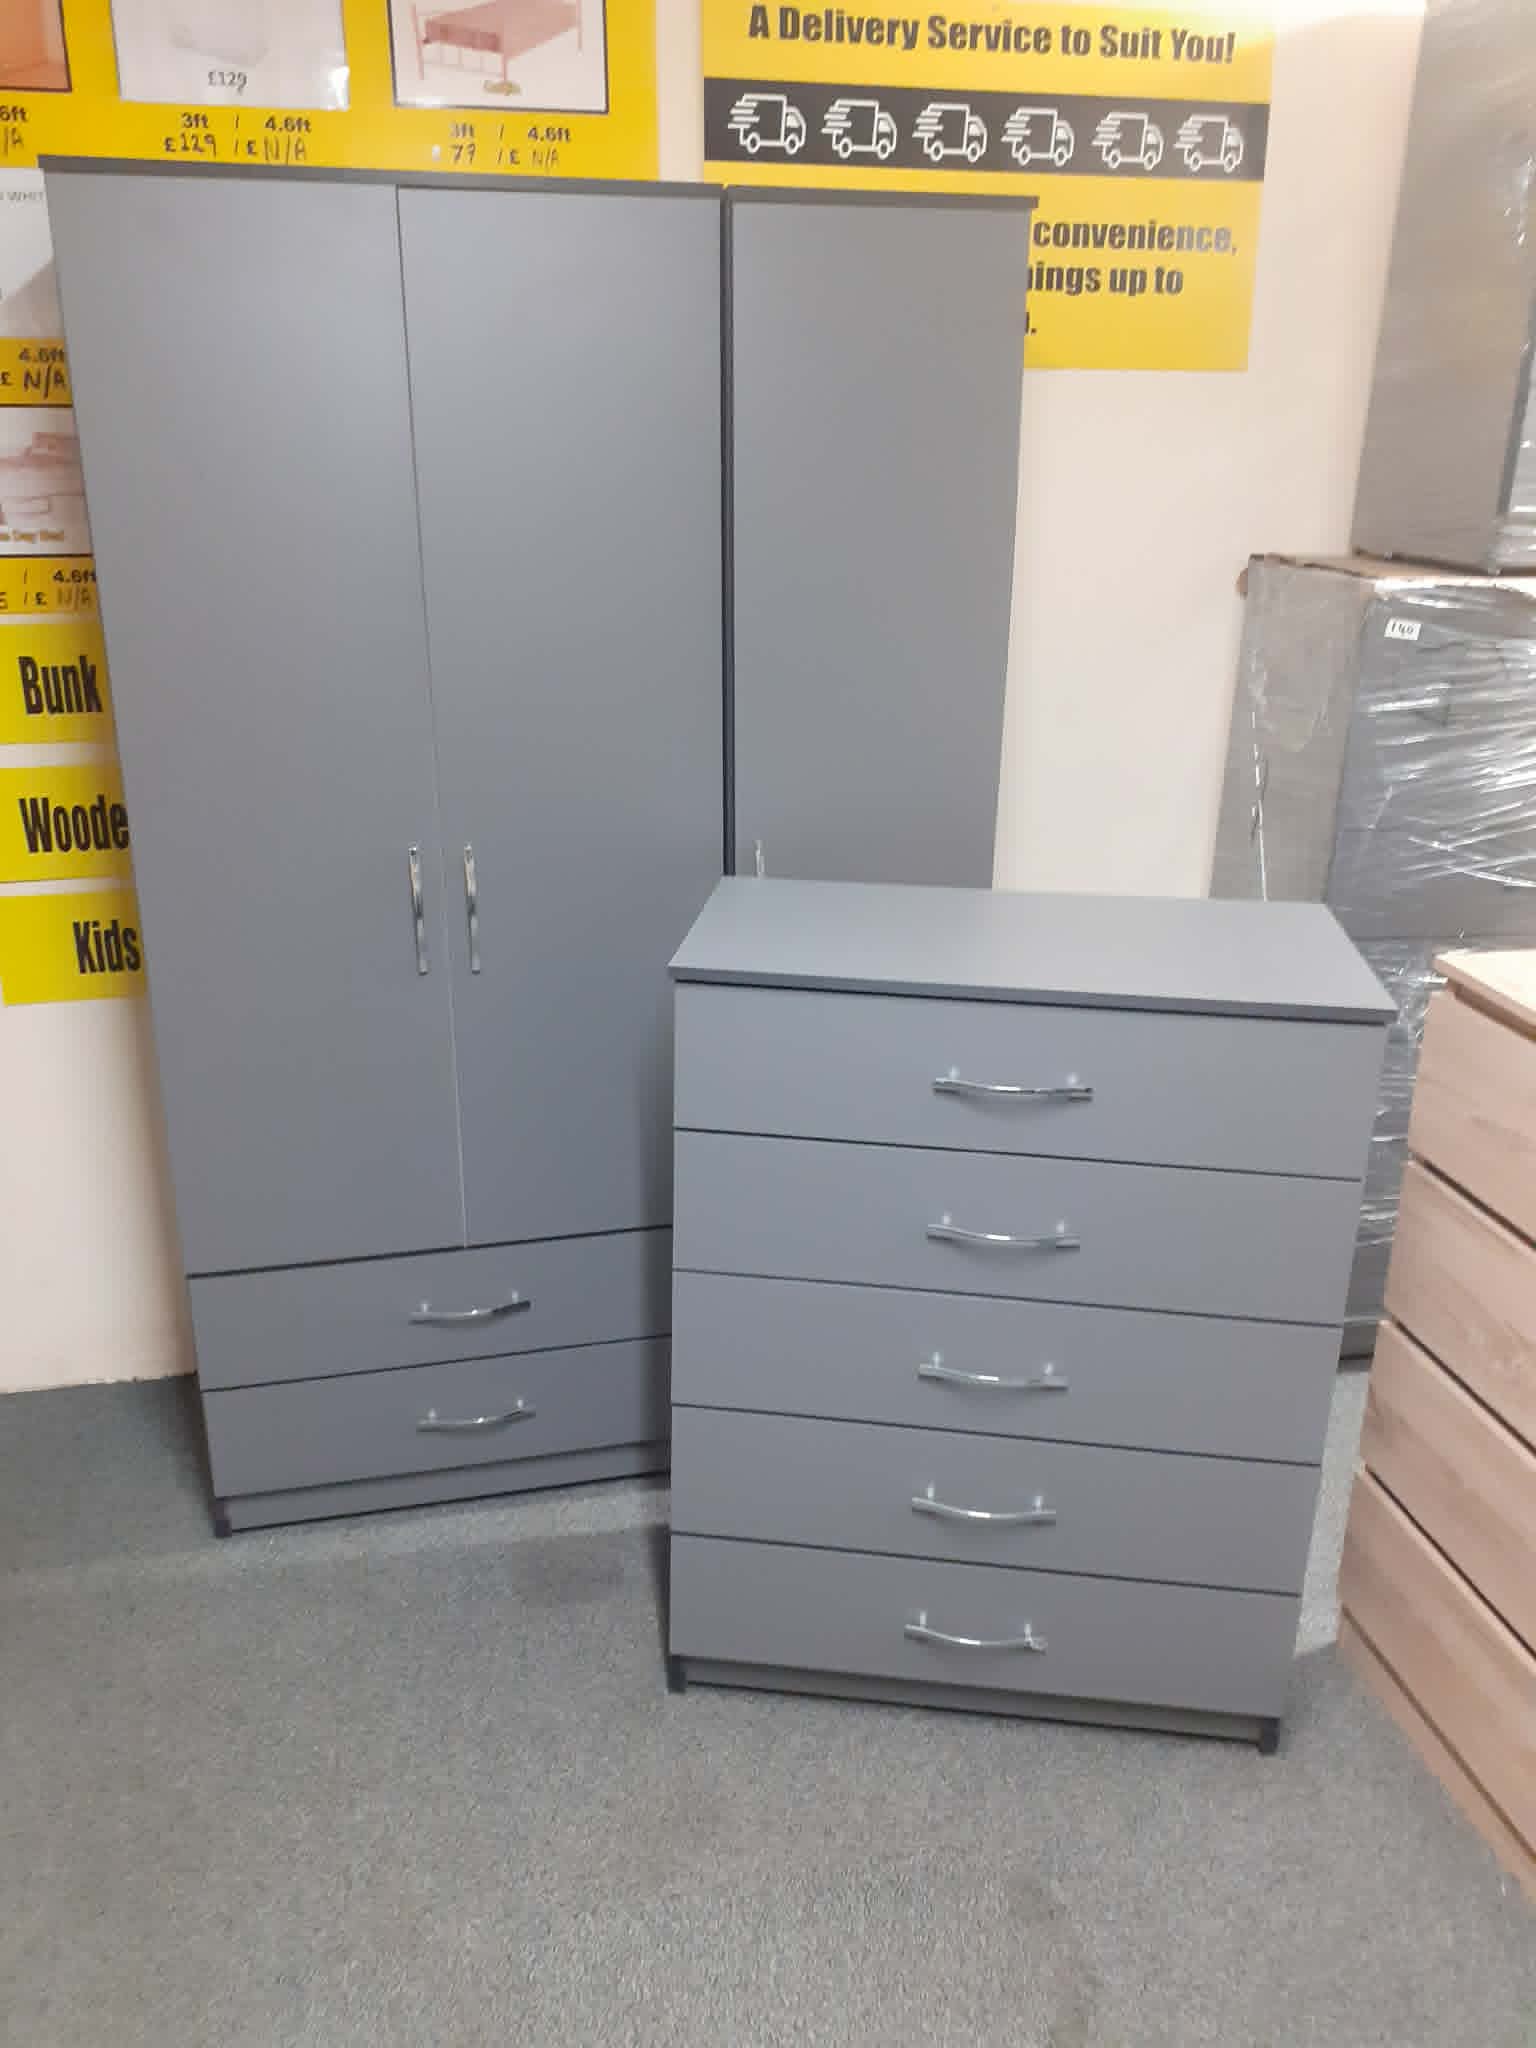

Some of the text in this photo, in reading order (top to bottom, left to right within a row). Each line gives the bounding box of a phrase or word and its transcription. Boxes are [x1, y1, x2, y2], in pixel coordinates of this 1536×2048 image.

[748, 5, 1236, 63] A Delivery Service to Suit You!
[208, 71, 247, 95] £129
[182, 112, 208, 128] 3ft
[265, 115, 312, 133] 4.6ft
[528, 126, 571, 142] 4.6ft
[1033, 220, 1237, 255] convenience,
[1109, 268, 1148, 296] up
[1155, 267, 1183, 294] to
[18, 655, 103, 715] Bunk
[73, 920, 141, 974] Kids
